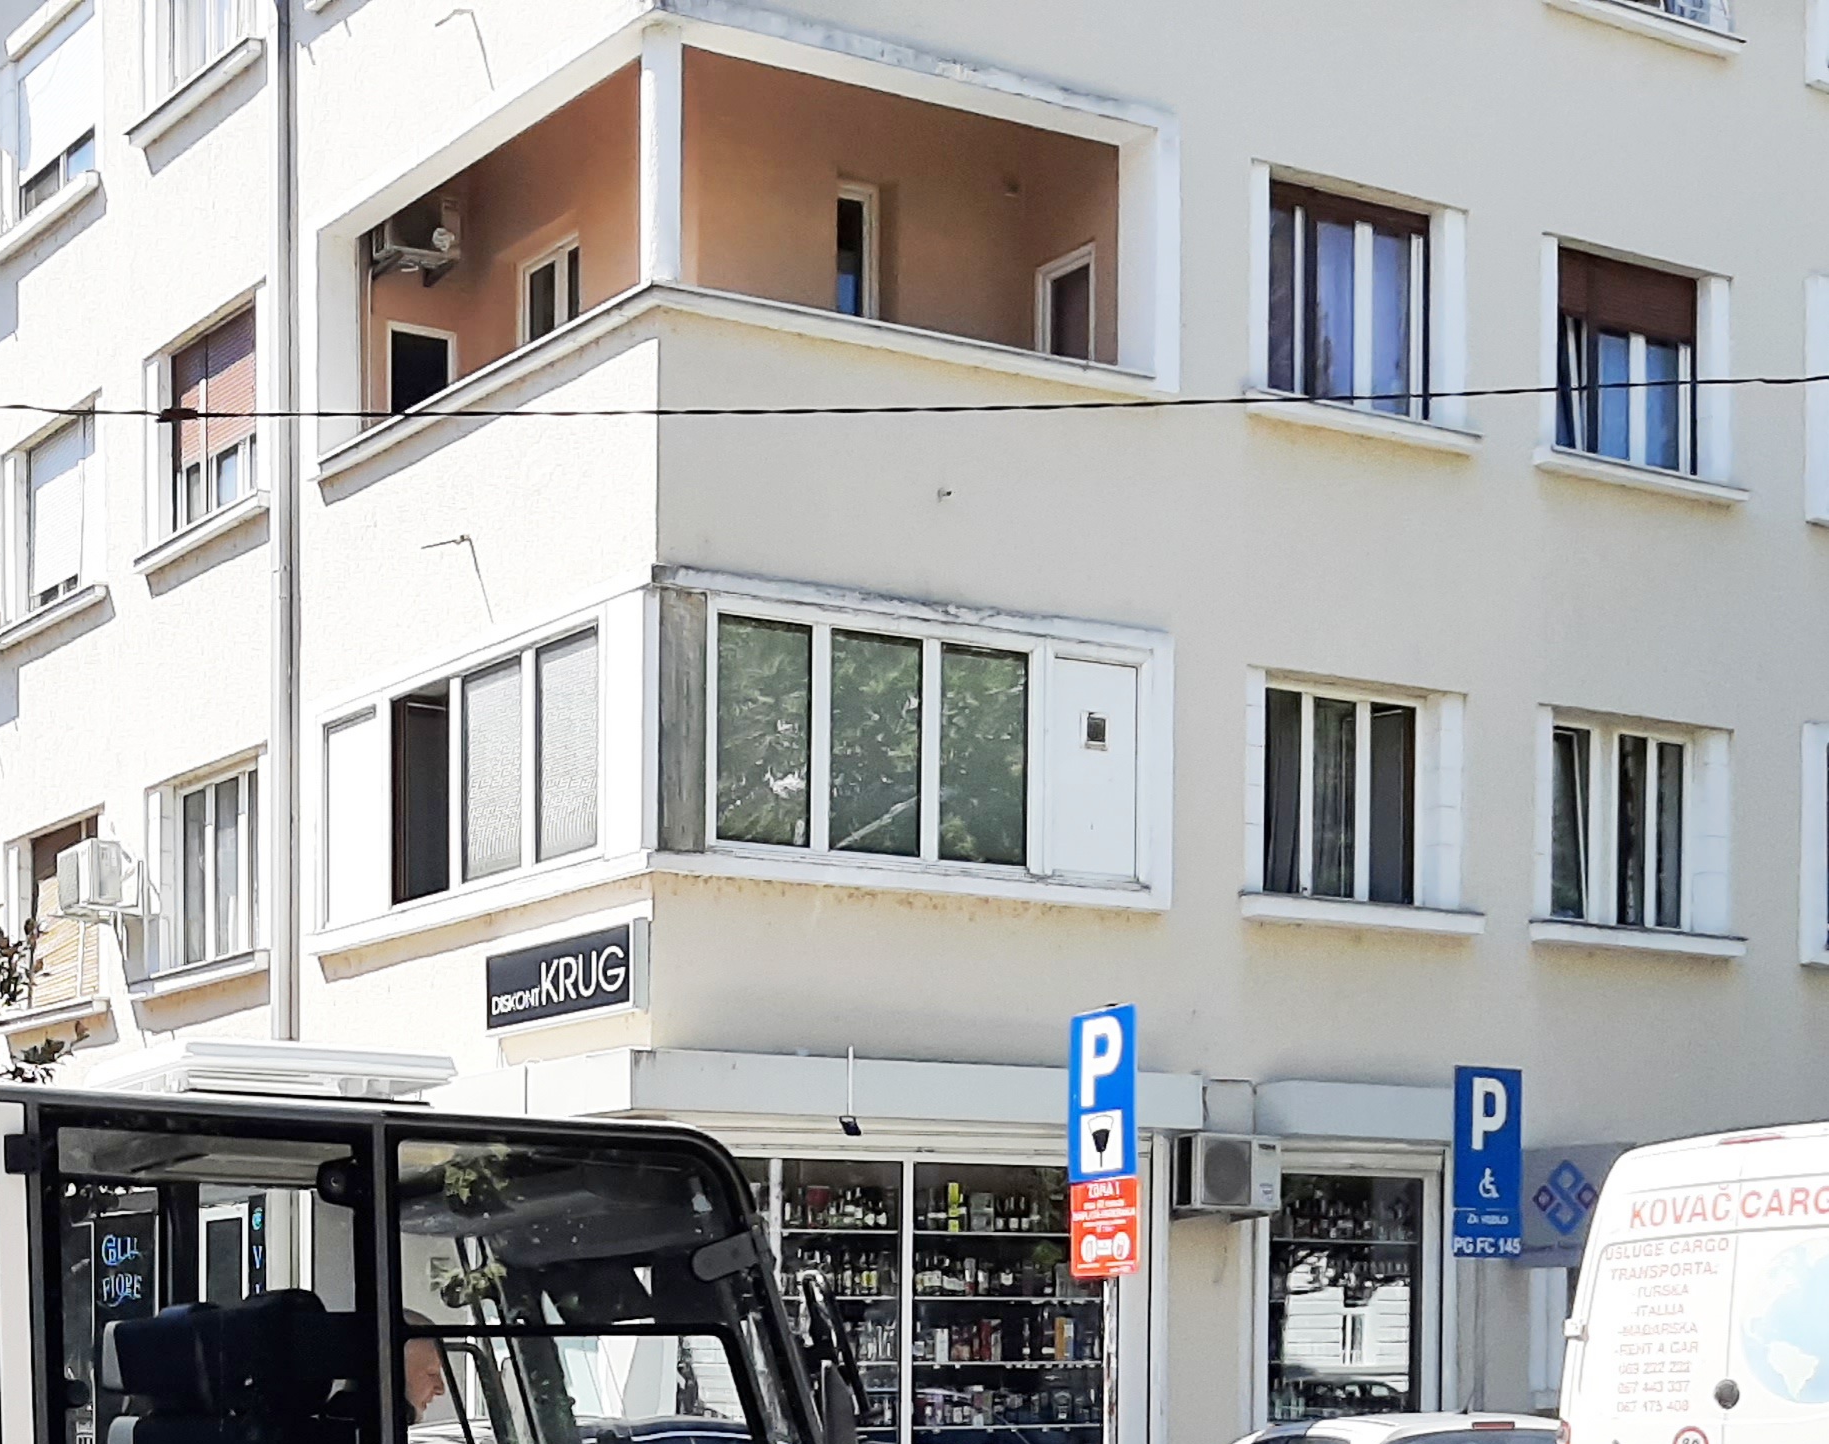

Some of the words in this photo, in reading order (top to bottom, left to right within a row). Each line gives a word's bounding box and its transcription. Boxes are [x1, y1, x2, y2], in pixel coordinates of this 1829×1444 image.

[490, 985, 540, 1015] DISKONT
[540, 944, 627, 1006] KRUG
[1080, 1015, 1123, 1109] P
[1471, 1076, 1508, 1151] P
[1629, 1183, 1732, 1229] KOVAČ
[1453, 1236, 1474, 1254] PG
[1475, 1236, 1495, 1254] FC
[1498, 1236, 1521, 1254] 145
[1604, 1242, 1664, 1261] USLUGE
[1670, 1237, 1729, 1254] CARGO
